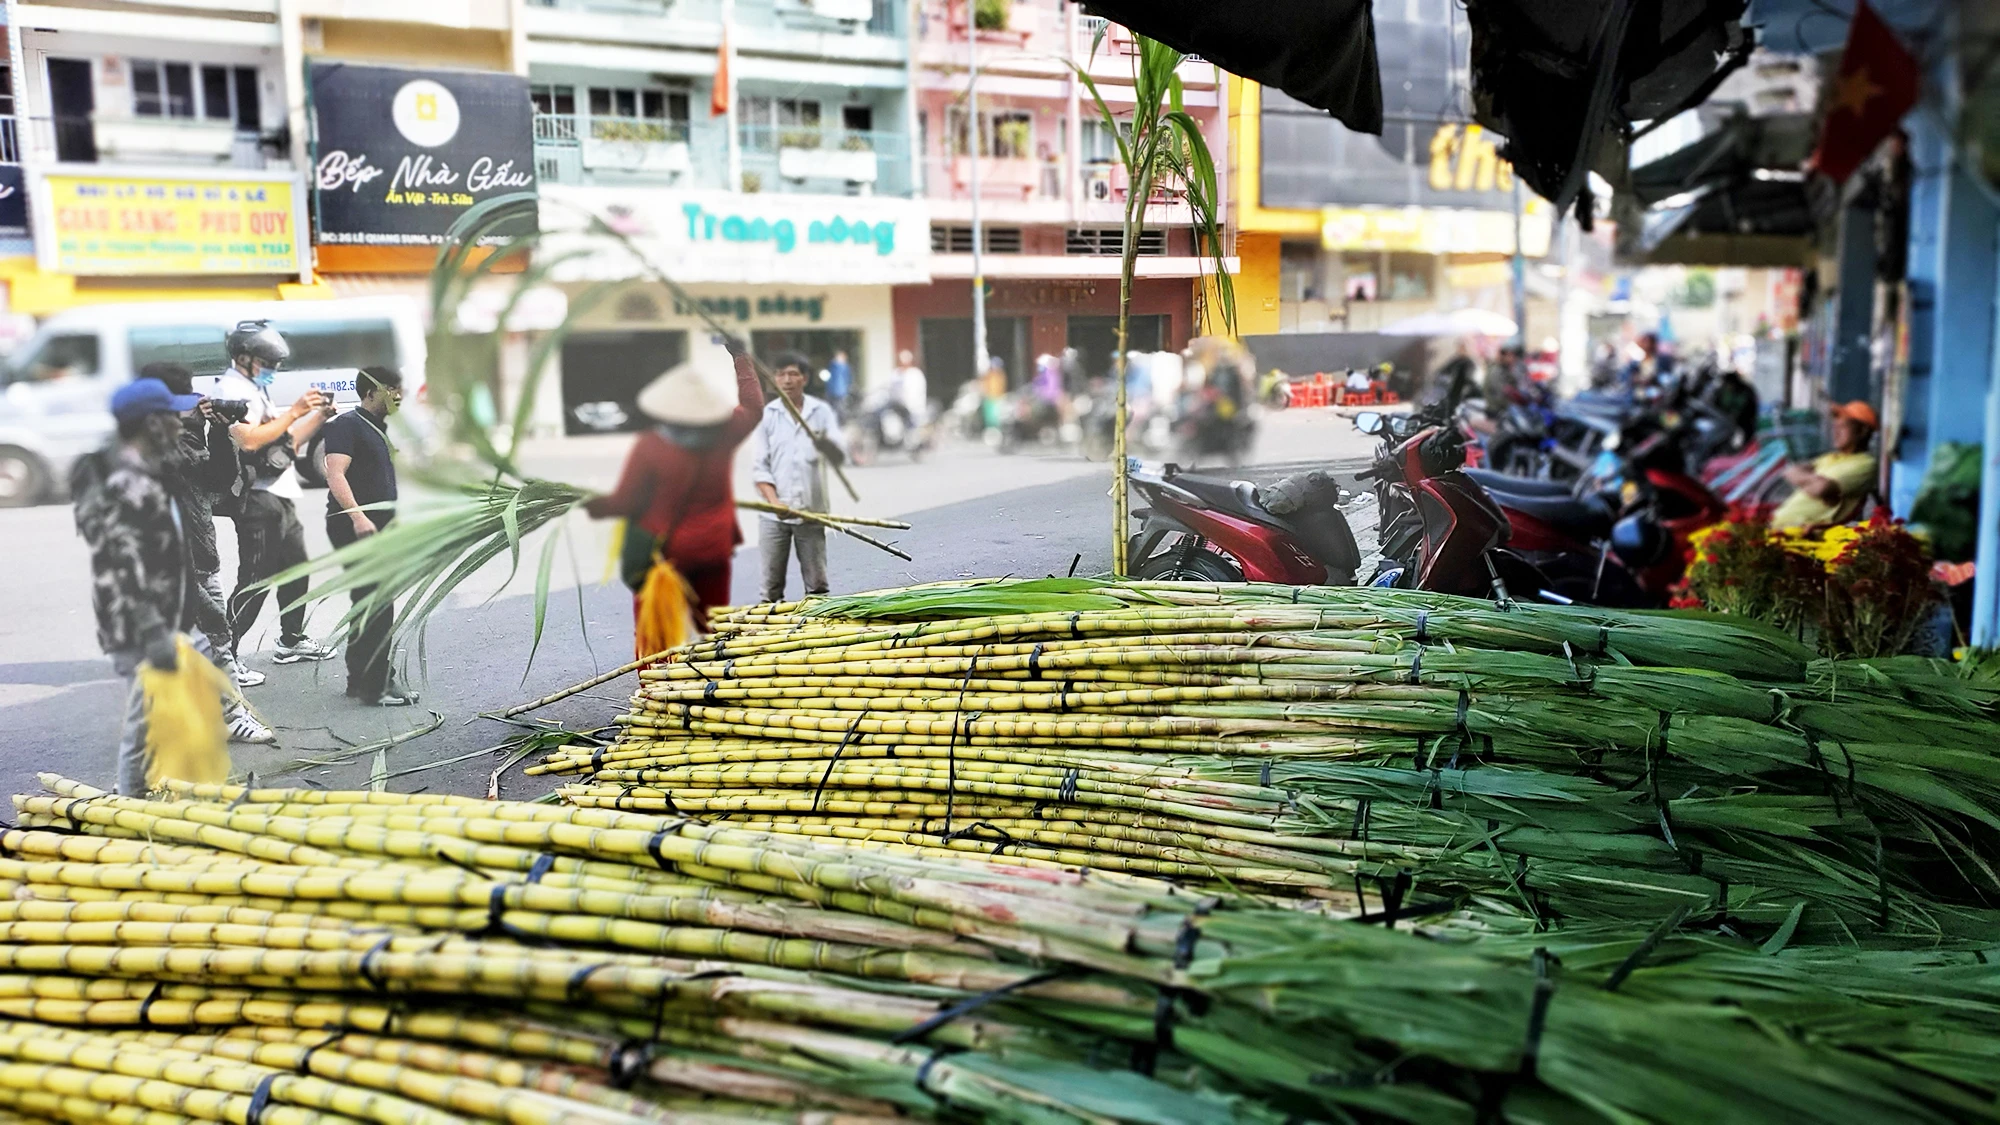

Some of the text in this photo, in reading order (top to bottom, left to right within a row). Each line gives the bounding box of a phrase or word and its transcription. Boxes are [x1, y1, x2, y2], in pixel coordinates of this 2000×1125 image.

[317, 151, 533, 193] Bếp Nhà Gấu
[682, 203, 896, 256] Trang nông
